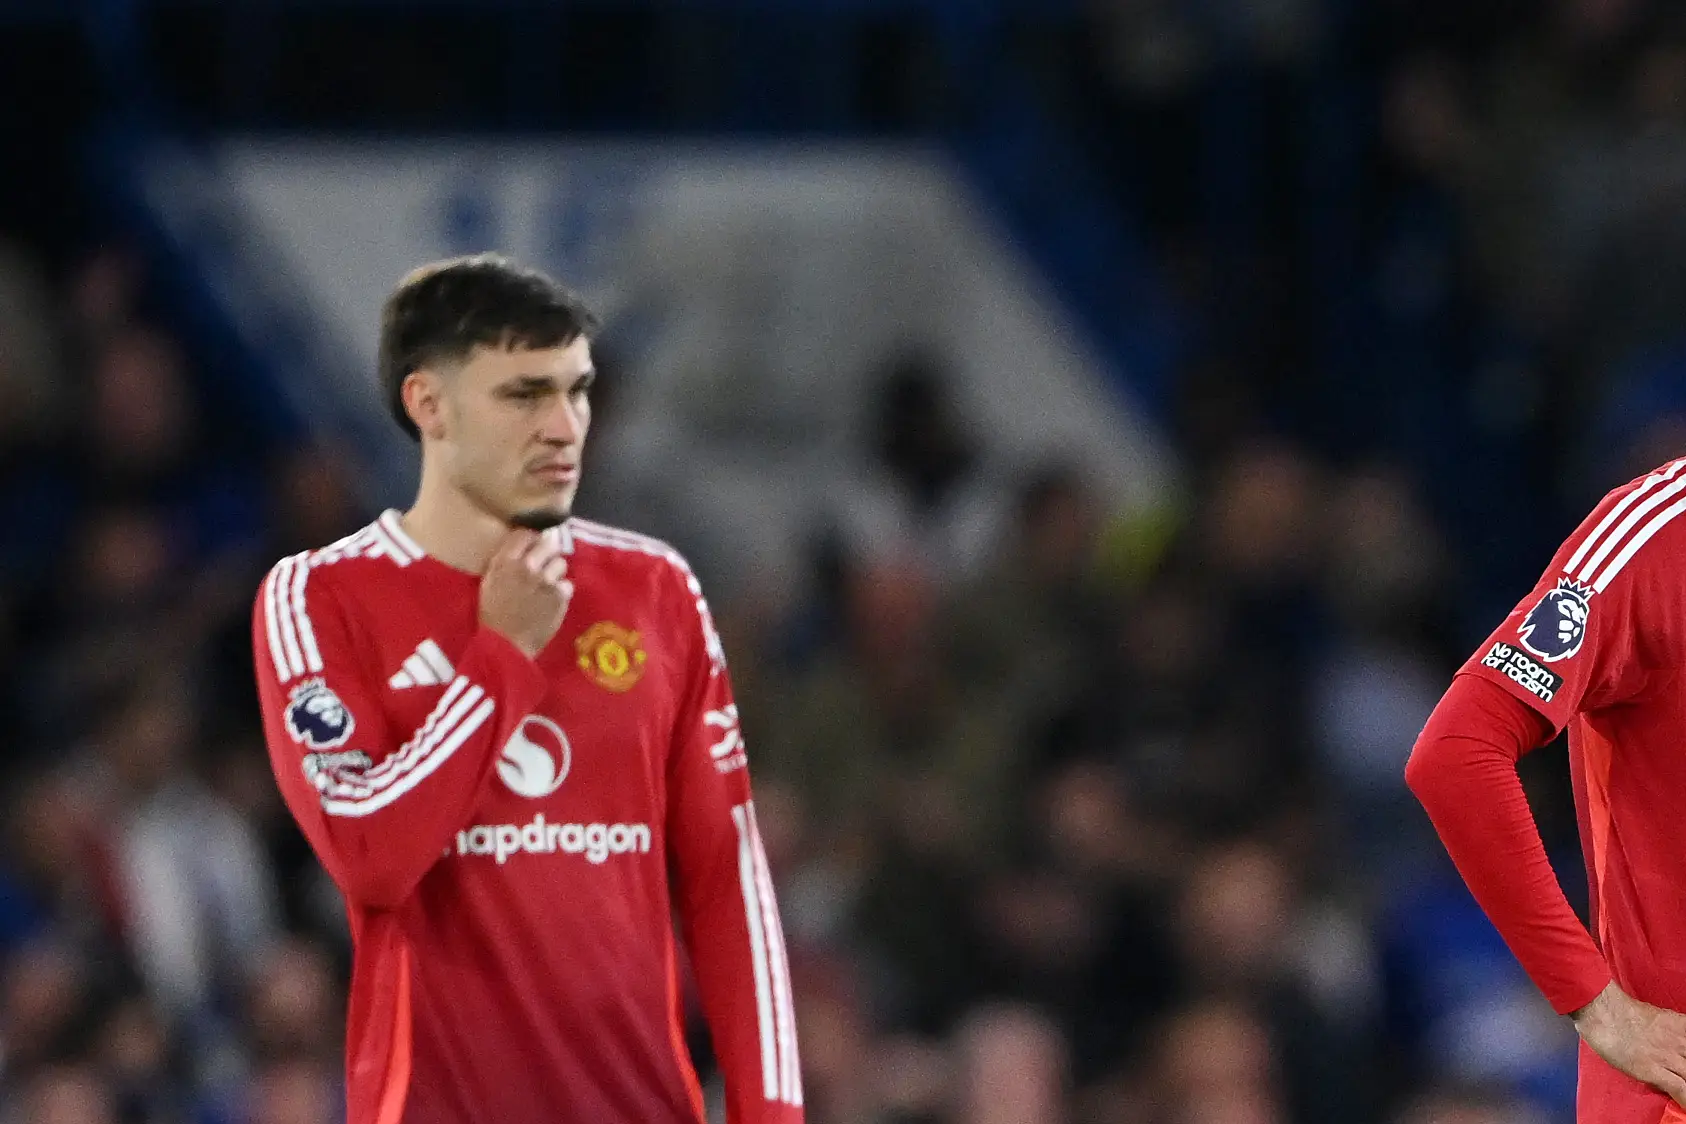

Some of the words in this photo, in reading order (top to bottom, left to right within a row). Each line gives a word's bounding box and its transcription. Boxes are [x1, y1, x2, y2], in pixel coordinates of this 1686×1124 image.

[1488, 642, 1512, 659] No
[1510, 652, 1554, 687] room
[1501, 661, 1554, 702] racism
